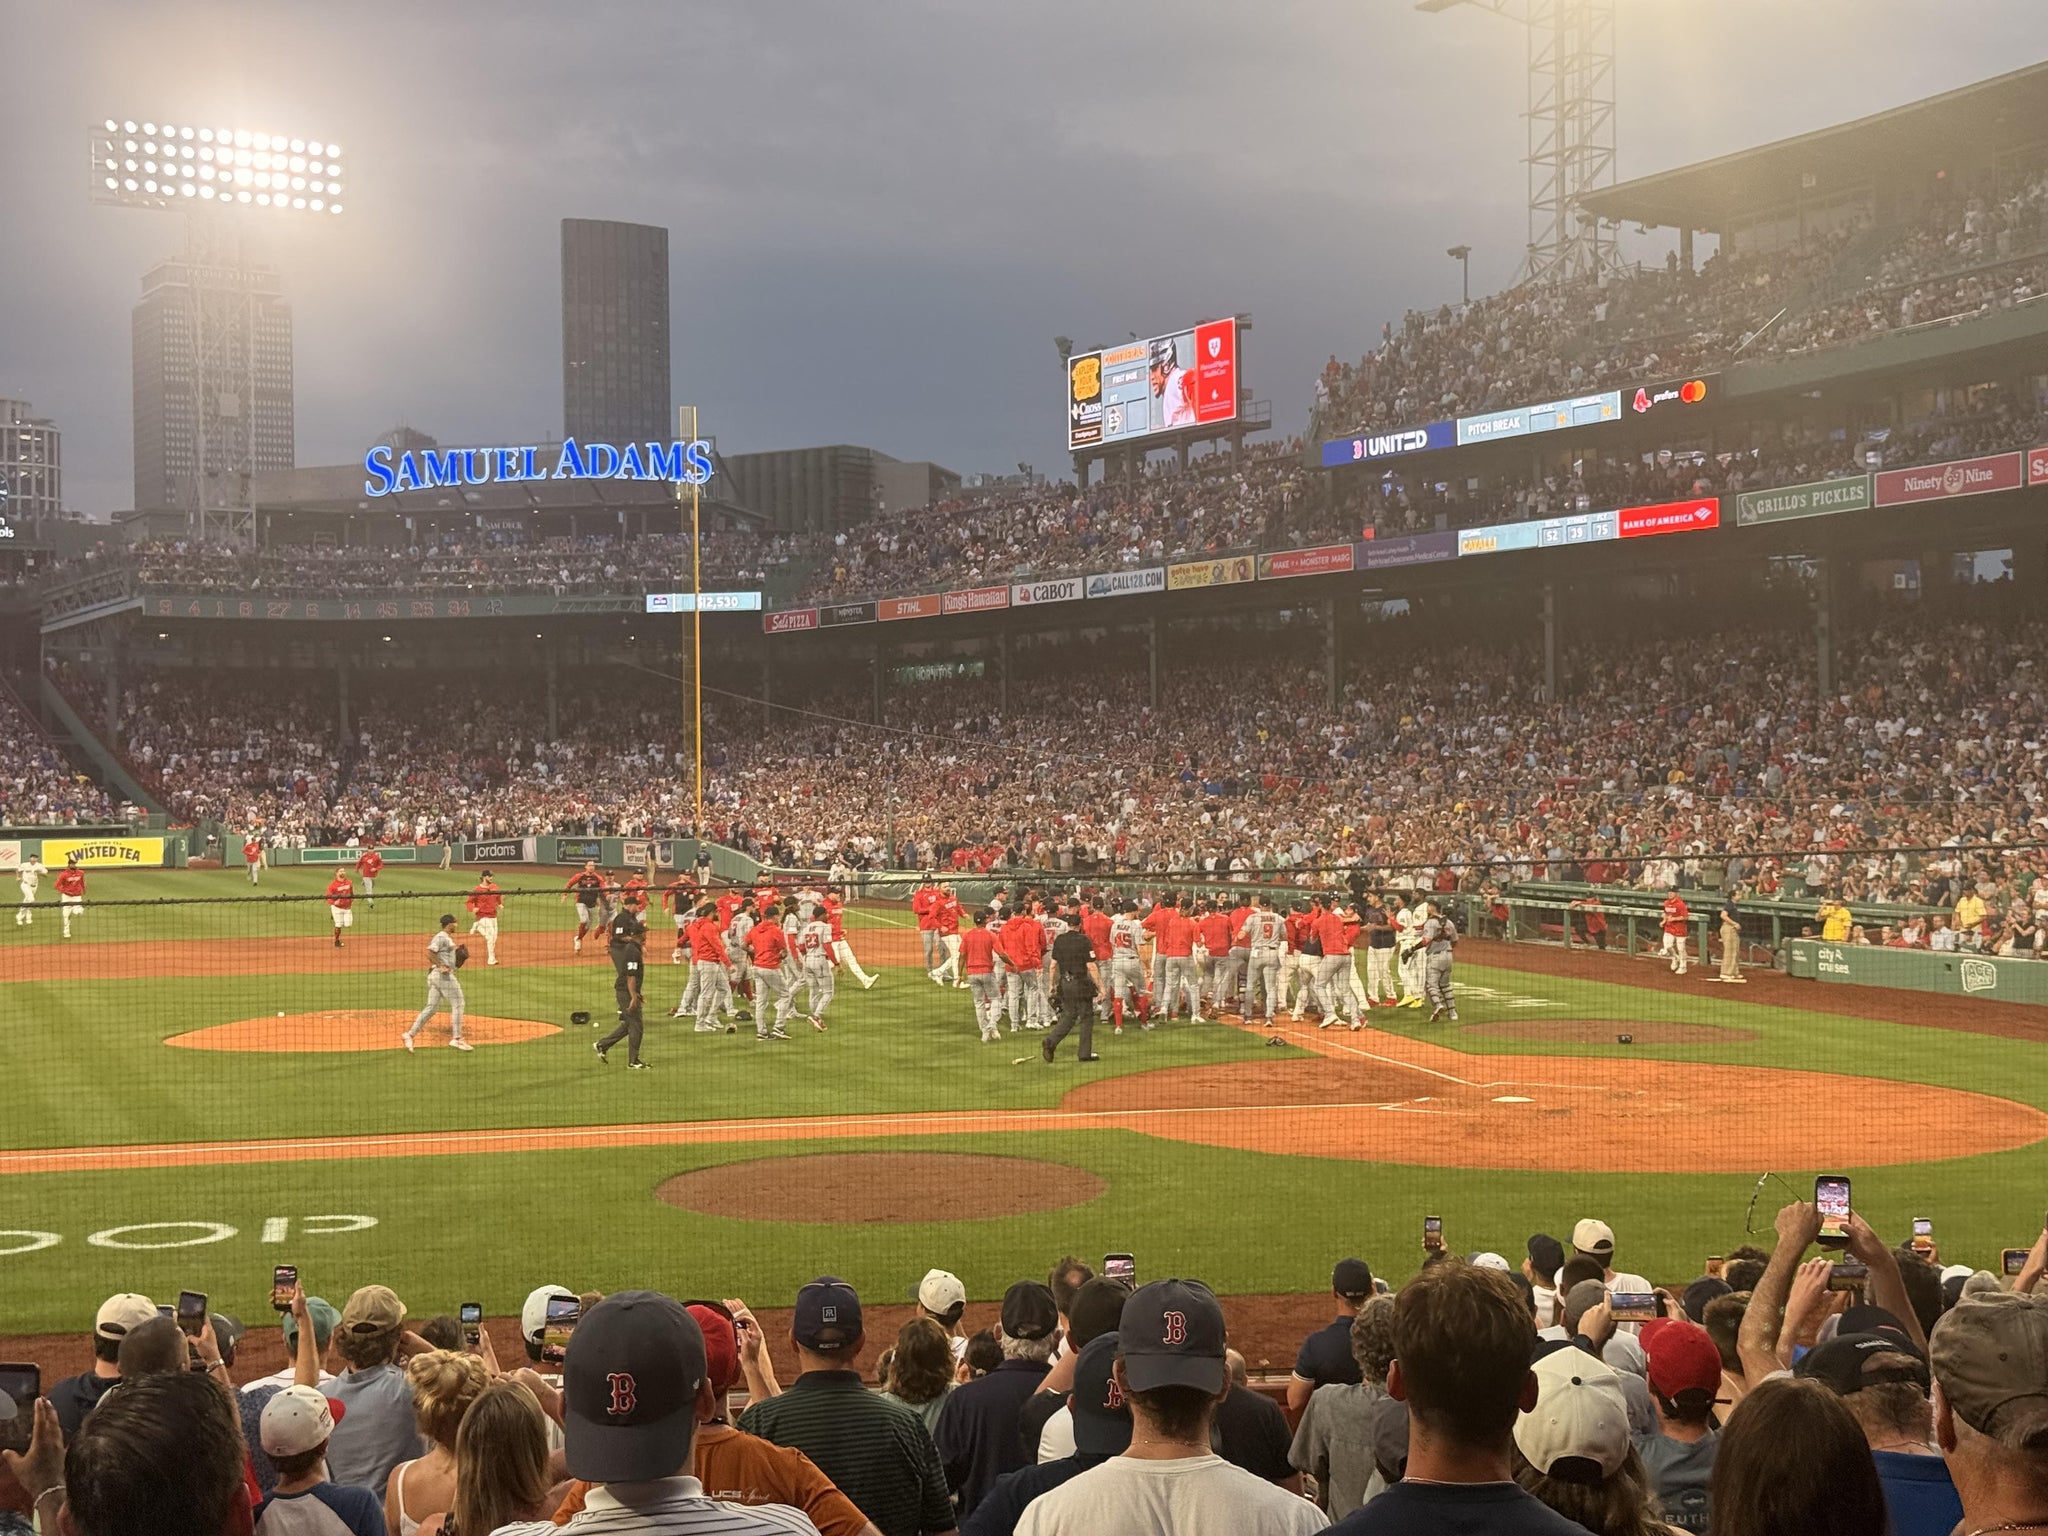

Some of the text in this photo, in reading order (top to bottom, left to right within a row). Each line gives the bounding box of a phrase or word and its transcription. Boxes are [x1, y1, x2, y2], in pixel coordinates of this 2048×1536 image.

[1103, 346, 1145, 366] CONTRERAS
[1654, 390, 1679, 403] prefers
[1468, 416, 1521, 436] PITCH BREAK
[365, 437, 714, 497] SAMUEL ADAMS
[1904, 477, 1942, 492] Ninety
[1966, 469, 1993, 483] Nine
[1757, 485, 1864, 514] GRILLO'S PICKLES
[486, 522, 500, 530] SAM
[1623, 513, 1694, 529] BANK OF AMERICA
[1546, 530, 1558, 542] 52
[1463, 537, 1497, 552] CAVALLI
[1273, 560, 1289, 569] MAKE
[1300, 556, 1329, 566] MONSTER
[1331, 553, 1350, 563] MARG
[1112, 571, 1162, 590] CALL128.COM
[896, 602, 922, 614] STIHL
[945, 590, 1007, 611] King's Hawaiian
[188, 600, 200, 616] 4
[216, 600, 224, 616] 1
[267, 602, 290, 618] 27
[343, 602, 361, 619] 14
[485, 599, 503, 615] 42
[789, 614, 811, 628] PIZZA
[180, 840, 186, 851] 3
[65, 846, 140, 862] TWISTED TEA
[1263, 923, 1274, 939] 9
[1818, 947, 1835, 962] city
[1818, 962, 1850, 974] cruises
[1966, 962, 1993, 977] ACE
[1163, 1311, 1187, 1344] B
[607, 1373, 637, 1415] B
[712, 1489, 742, 1498] UCS
